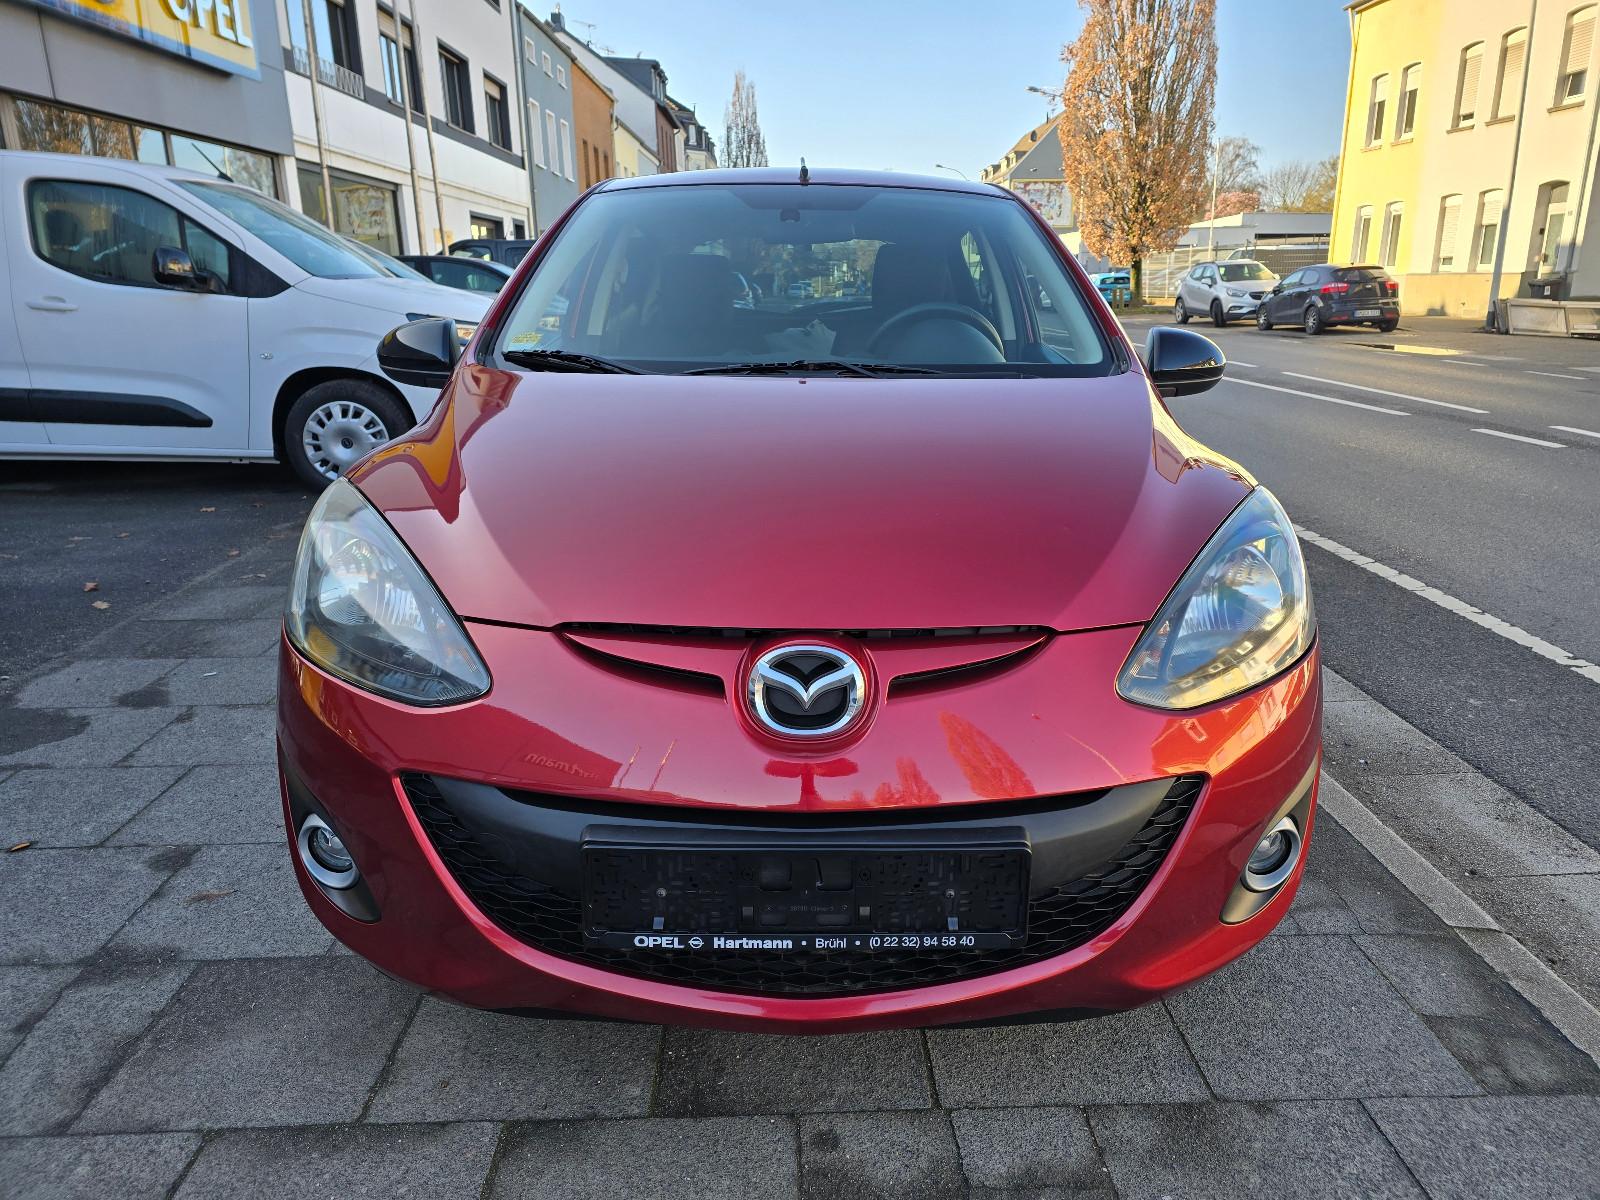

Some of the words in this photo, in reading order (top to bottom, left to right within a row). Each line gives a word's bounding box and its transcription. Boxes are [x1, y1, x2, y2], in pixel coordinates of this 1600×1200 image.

[634, 936, 685, 949] OPEL
[713, 937, 793, 949] Hartmann
[815, 937, 847, 949] Brühl
[869, 936, 881, 949] (0
[883, 936, 899, 947] 22
[901, 936, 920, 949] 32)
[923, 936, 938, 947] 94
[941, 936, 957, 947] 58
[959, 935, 975, 946] 40
